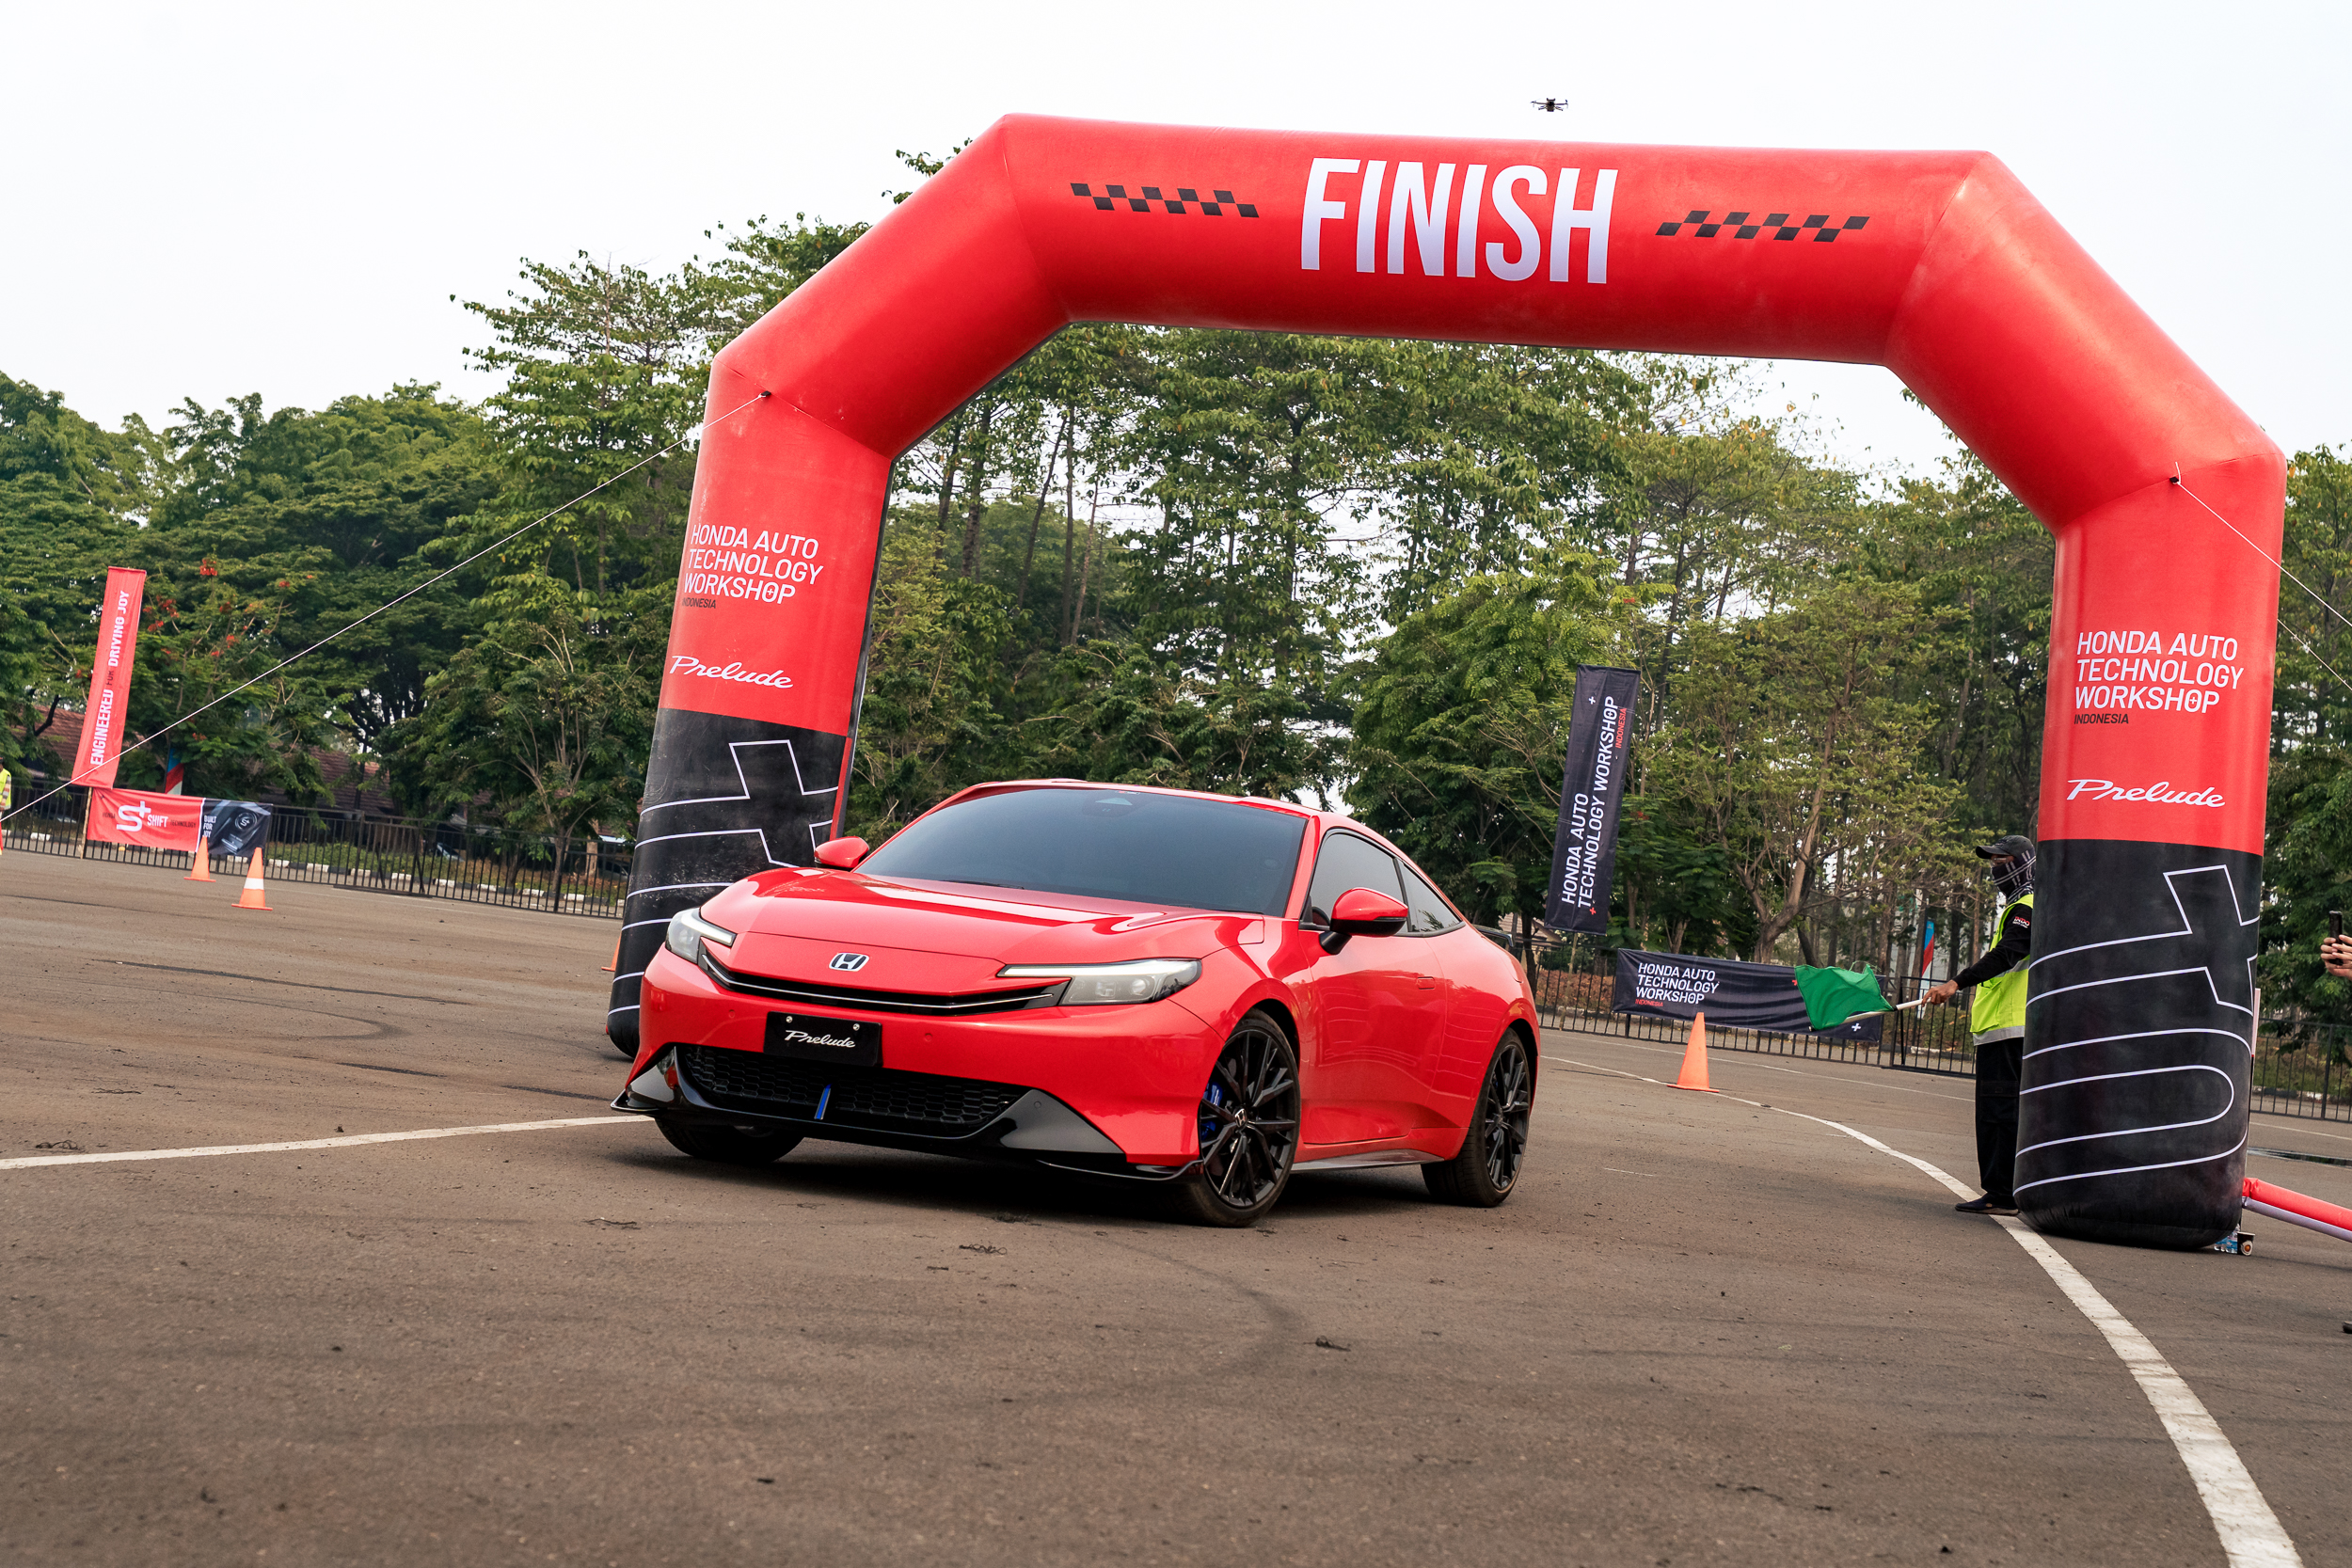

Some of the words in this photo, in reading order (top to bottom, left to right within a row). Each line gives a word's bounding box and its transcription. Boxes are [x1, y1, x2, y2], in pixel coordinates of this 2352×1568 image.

[1301, 157, 1618, 284] FINISH
[691, 524, 748, 548] HONDA
[753, 531, 819, 560] AUTO
[688, 548, 823, 585] TECHNOLOGY
[118, 590, 130, 614] JOY
[684, 573, 795, 605] WORKSHOP
[108, 616, 125, 667] DRIVING
[2076, 630, 2162, 655] HONDA
[2168, 632, 2238, 661] AUTO
[105, 670, 114, 686] FOR
[669, 656, 793, 689] Prelude
[2076, 658, 2244, 689] TECHNOLOGY
[2075, 686, 2220, 713] WORKSHOP
[90, 689, 114, 766] ENGINEERED
[1615, 707, 1628, 749] INDONESIA
[2074, 713, 2129, 724] INDONESIA
[1578, 796, 1605, 909] TECHNOLOGY
[1594, 696, 1618, 791] WORKSHOP
[2066, 779, 2226, 808] Prelude
[147, 814, 168, 828] SHIFT
[170, 819, 197, 828] TECHNOLOGY
[1570, 793, 1589, 840] AUTO
[1562, 846, 1582, 905] HONDA
[1638, 962, 1679, 977] HONDA
[1682, 968, 1715, 981] AUTO
[1638, 974, 1719, 993] TECHNOLOGY
[1636, 987, 1705, 1004] WORKSHOP
[785, 1030, 855, 1048] Prelude
